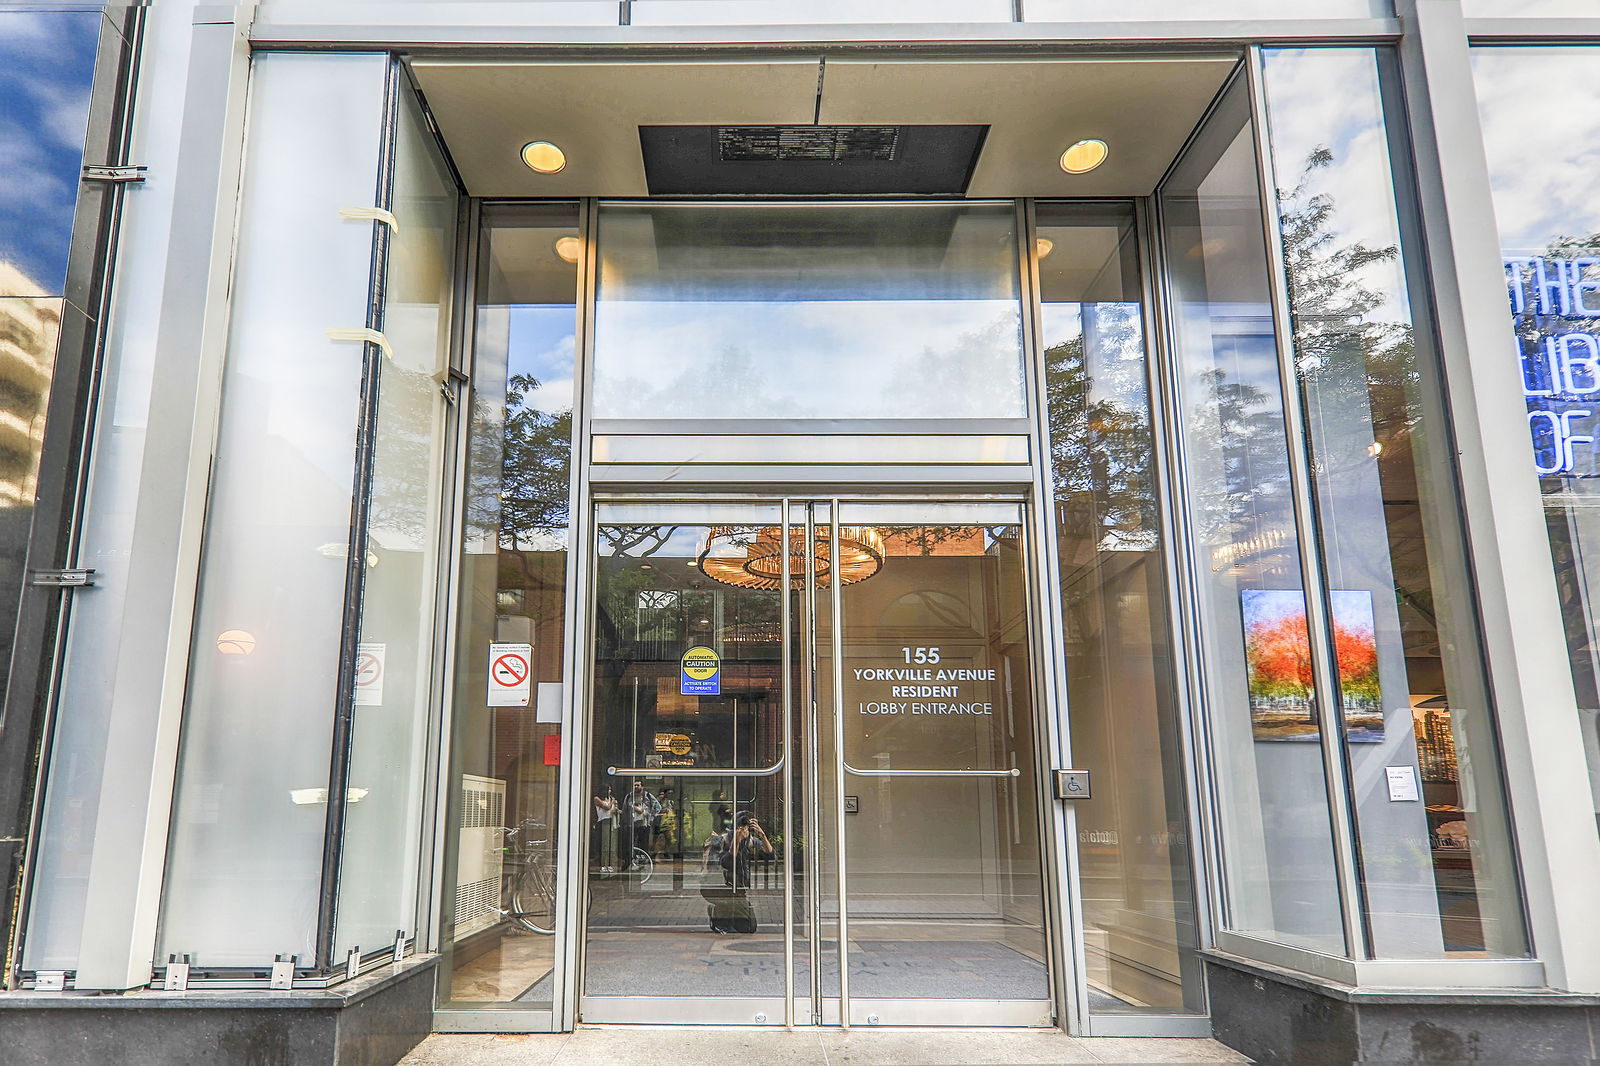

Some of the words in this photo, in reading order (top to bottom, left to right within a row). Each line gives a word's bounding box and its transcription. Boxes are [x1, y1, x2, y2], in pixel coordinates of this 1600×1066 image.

[1503, 256, 1600, 317] THE
[1514, 333, 1600, 396] LIB
[1527, 410, 1595, 475] OF
[901, 647, 940, 664] 155
[853, 669, 932, 681] YORKVILLE
[936, 669, 996, 681] AVENUE
[892, 686, 959, 698] RESIDENT
[859, 702, 907, 715] LOBBY
[912, 702, 992, 715] ENTRANCE
